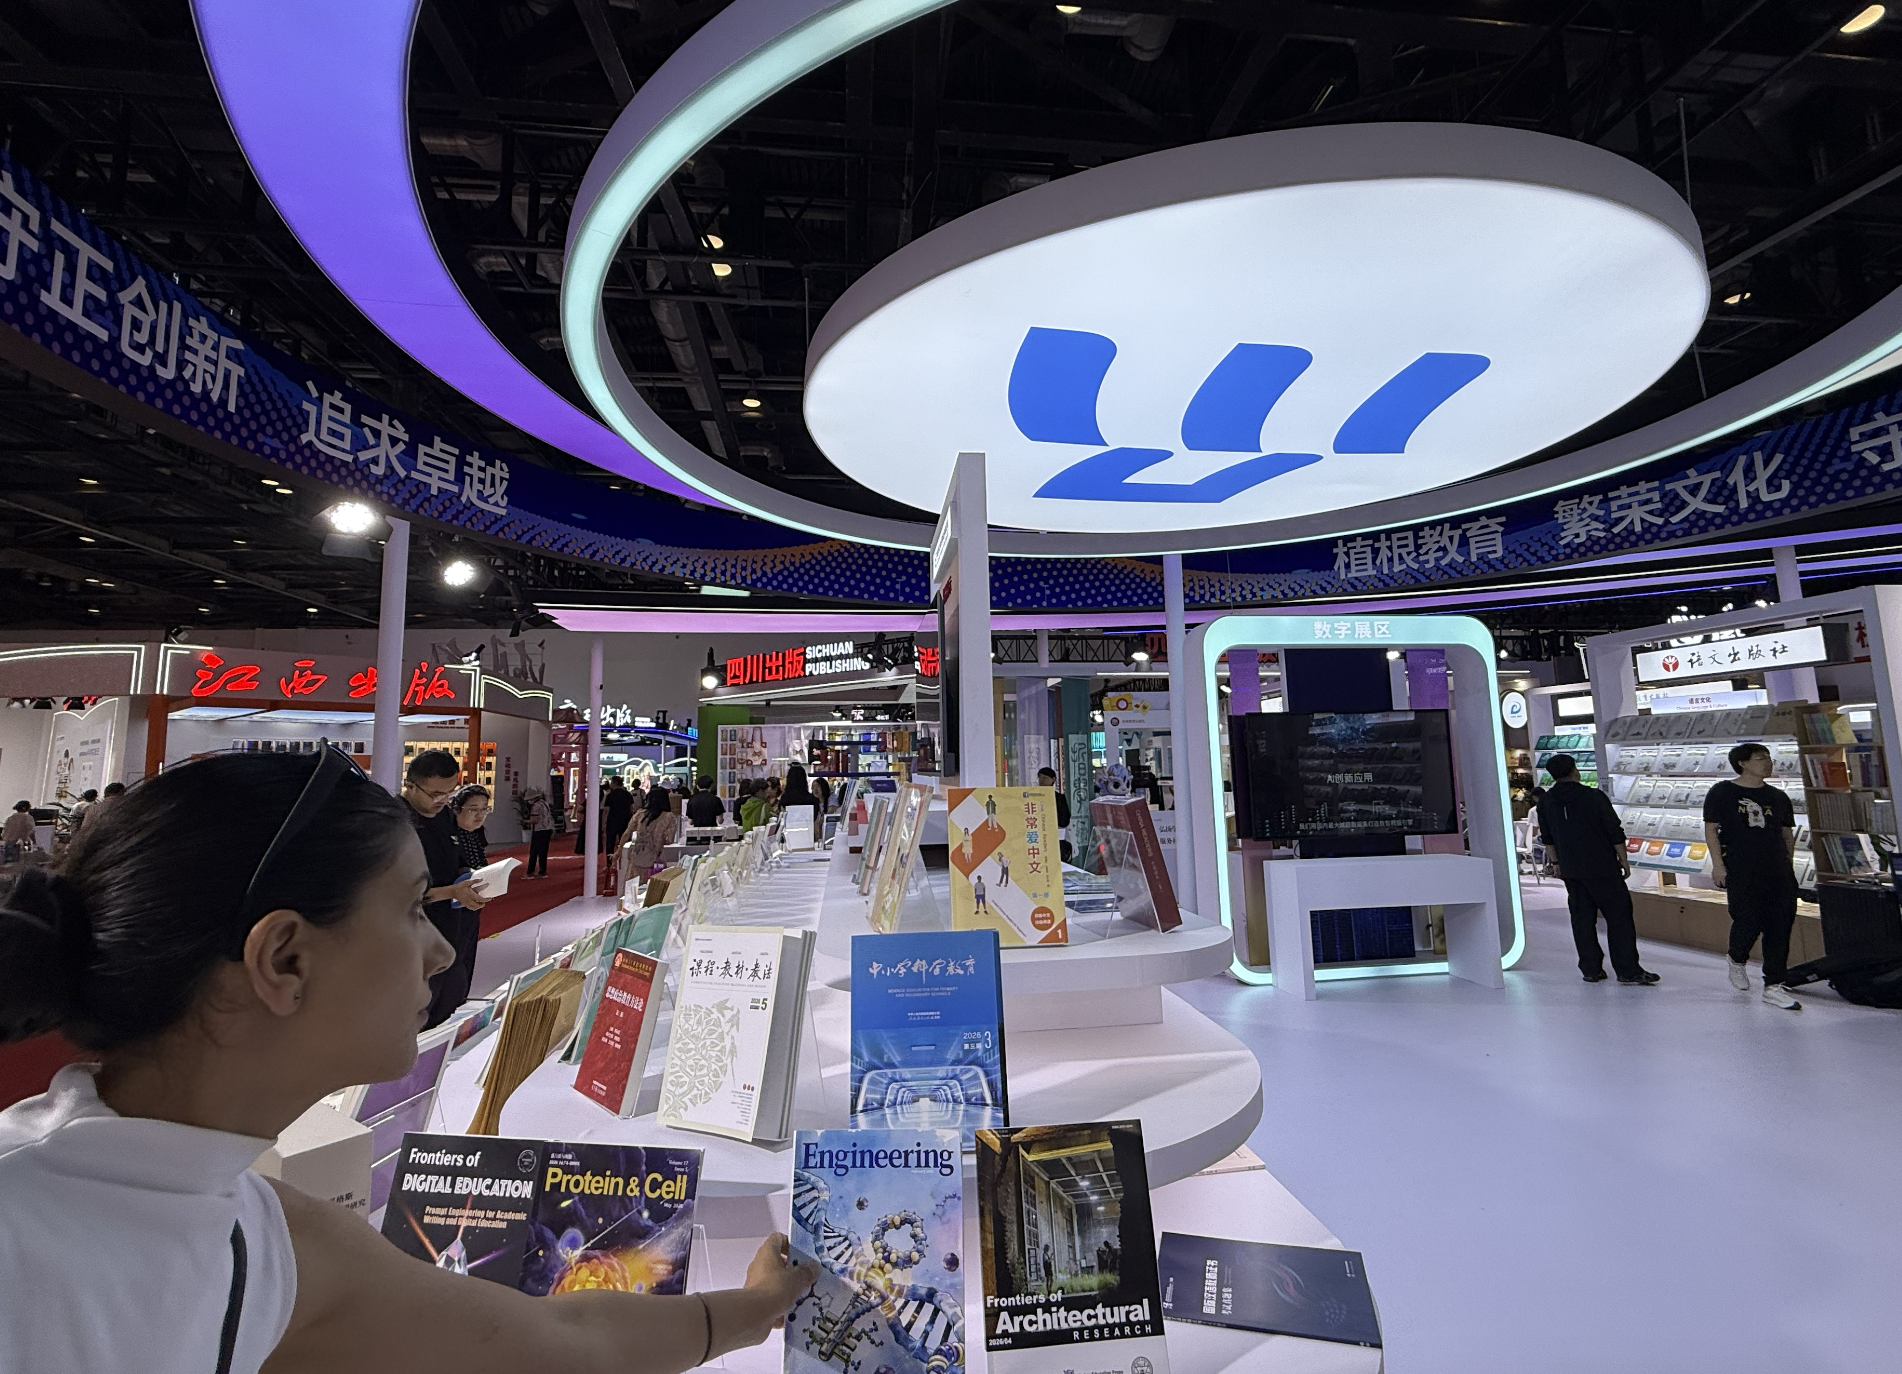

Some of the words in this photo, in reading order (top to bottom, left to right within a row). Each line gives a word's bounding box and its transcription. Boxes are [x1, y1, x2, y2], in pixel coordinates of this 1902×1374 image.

[300, 380, 511, 516] 追求卓越
[1553, 451, 1791, 546] 繁荣文化
[1332, 516, 1507, 579] 植根教育
[1313, 621, 1392, 639] 数字展区
[805, 640, 854, 659] SICHUAN
[1686, 640, 1789, 669] 语文出版社
[726, 647, 804, 686] 四川出版
[805, 657, 870, 676] PUBLISHING
[1688, 696, 1712, 705] 语言文化
[1326, 772, 1373, 784] AI创新应用
[1024, 801, 1041, 874] 非常爱中文
[1057, 929, 1062, 939] 1
[868, 955, 976, 984] 中小学科学教育
[760, 998, 768, 1011] 5
[984, 1031, 992, 1049] 3
[408, 1147, 464, 1167] Frontiers
[465, 1151, 482, 1168] of
[802, 1141, 954, 1177] Engineering
[402, 1173, 452, 1194] DIGITAL
[454, 1176, 534, 1199] EDUCATION
[544, 1166, 624, 1196] Protein
[626, 1176, 641, 1197] &
[644, 1172, 688, 1201] Cell
[423, 1215, 445, 1225] Writing
[445, 1216, 457, 1226] and
[478, 1219, 508, 1229] Education
[425, 1205, 447, 1215] Prompt
[448, 1207, 485, 1218] Engineering
[486, 1209, 496, 1217] for
[496, 1210, 528, 1221] Academic
[986, 1292, 1046, 1308] Frontiers
[1049, 1290, 1063, 1302] of
[995, 1298, 1151, 1335] Architectural
[1073, 1324, 1152, 1341] RESEARCH
